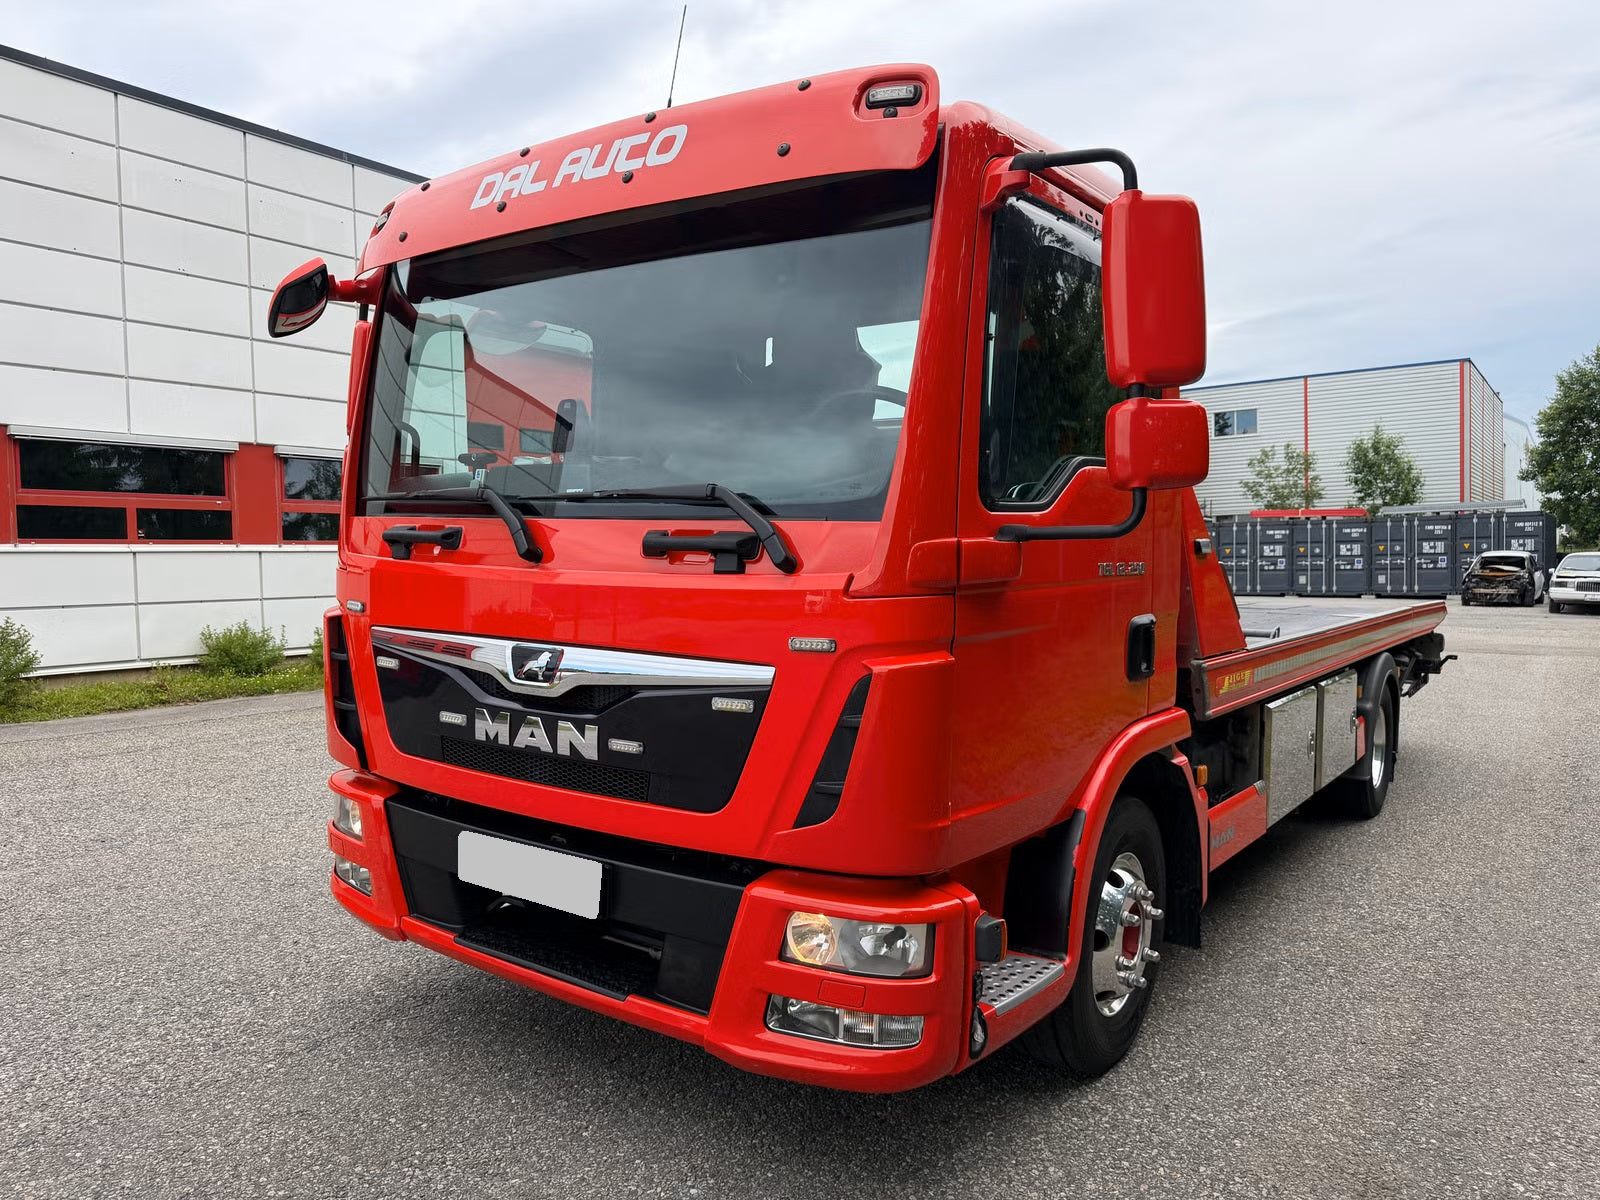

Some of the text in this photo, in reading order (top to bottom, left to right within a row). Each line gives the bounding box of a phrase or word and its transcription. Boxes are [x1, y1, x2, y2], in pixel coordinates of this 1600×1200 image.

[469, 124, 688, 210] DAL AUTO
[474, 707, 599, 761] MAN
[1210, 823, 1235, 851] MAN
